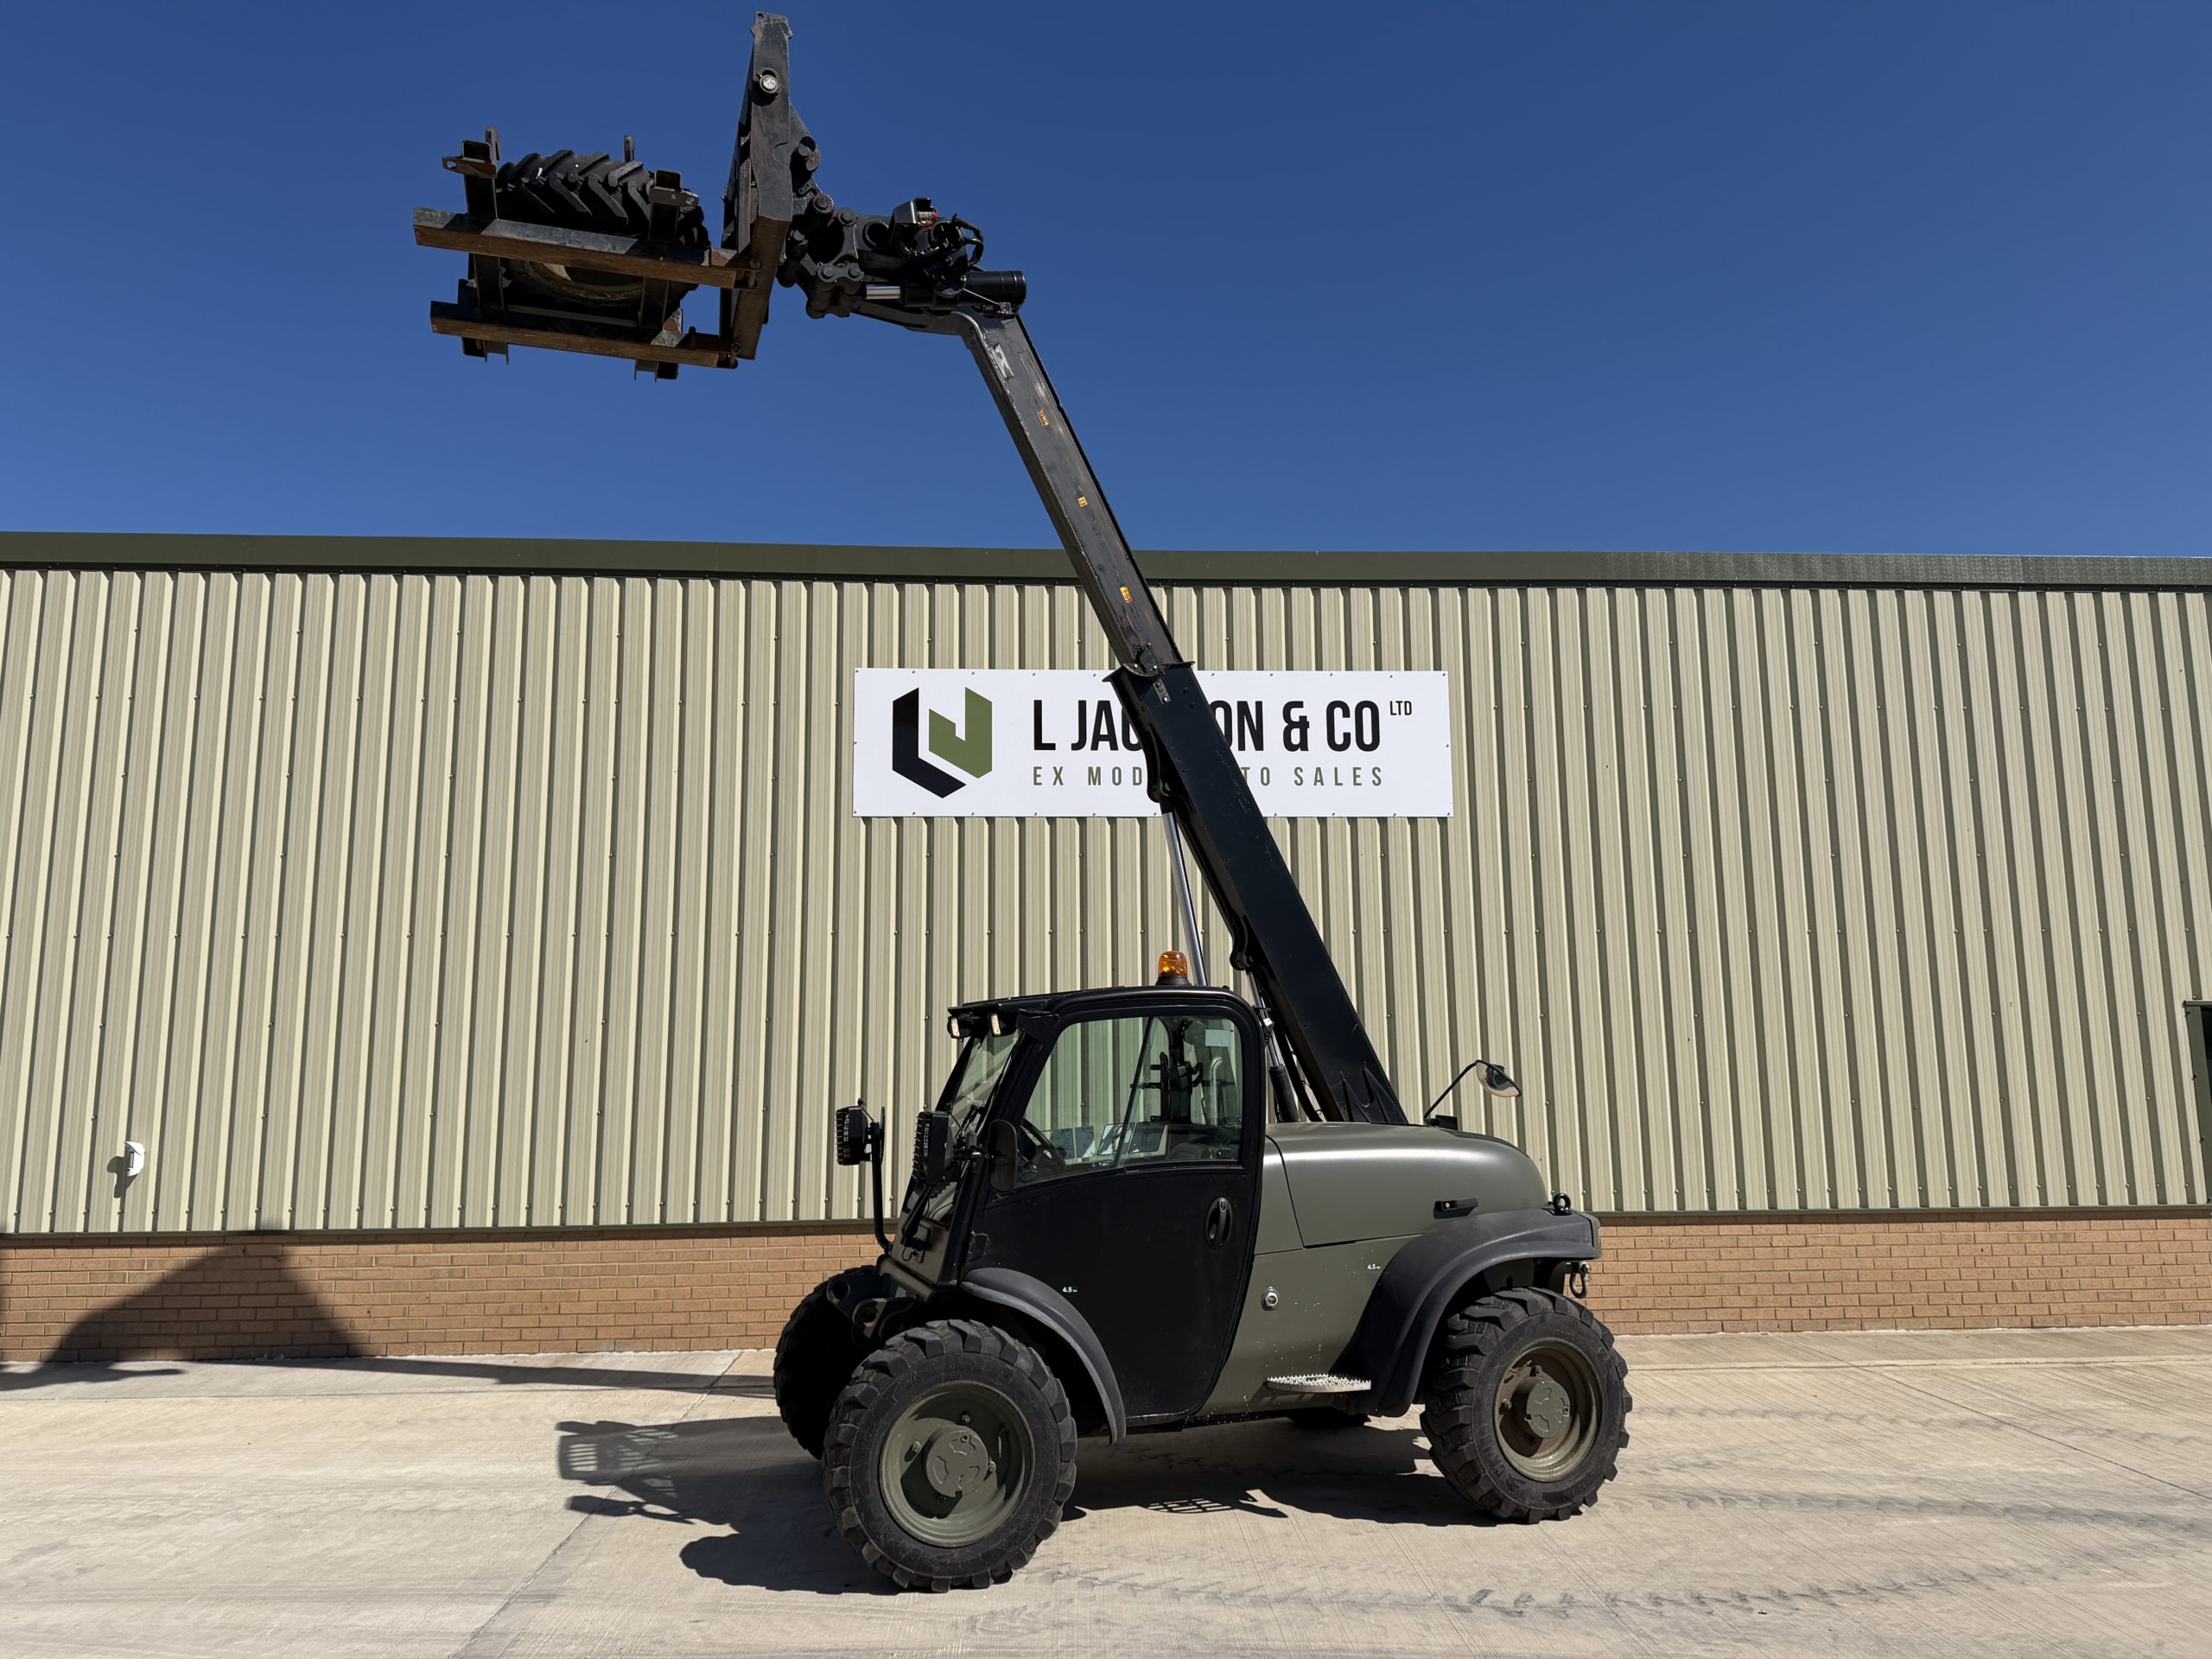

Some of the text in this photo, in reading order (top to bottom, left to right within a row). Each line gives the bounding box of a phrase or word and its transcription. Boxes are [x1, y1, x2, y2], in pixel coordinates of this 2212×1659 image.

[1389, 700, 1413, 716] LTD
[1033, 699, 1056, 751] L
[1282, 699, 1310, 753] &
[1325, 699, 1381, 753] CO
[1033, 766, 1064, 786] EX
[1087, 766, 1143, 786] MOD
[1294, 766, 1382, 787] SALES
